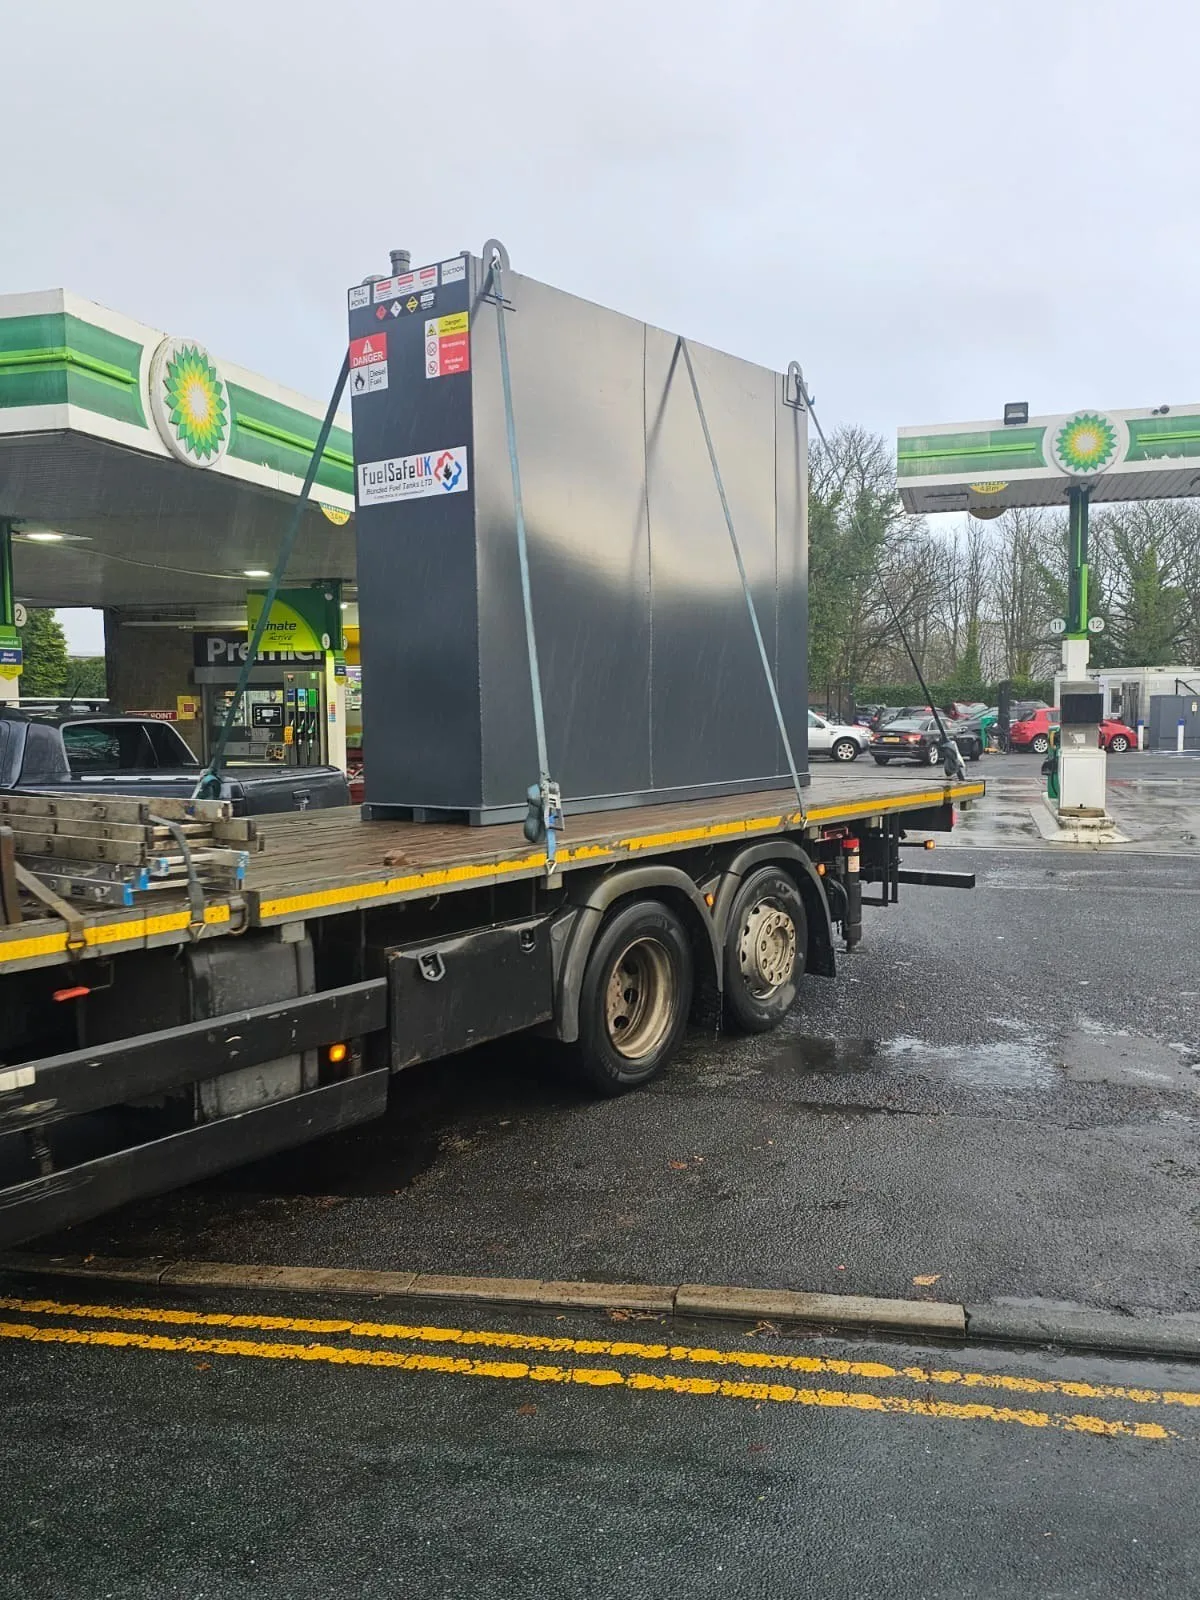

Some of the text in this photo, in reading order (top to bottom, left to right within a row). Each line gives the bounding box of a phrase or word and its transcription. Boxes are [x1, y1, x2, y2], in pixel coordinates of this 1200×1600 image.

[353, 288, 365, 297] FILL
[351, 297, 368, 306] POINT
[353, 351, 384, 367] DANGER
[370, 367, 386, 378] Diesel
[370, 376, 382, 386] Fuel
[363, 456, 433, 486] FuelSafeUK
[366, 486, 387, 495] Bunded
[389, 483, 401, 493] Fuel
[403, 481, 419, 490] Tanks
[421, 478, 433, 487] LTD
[16, 609, 22, 622] 2
[1052, 621, 1062, 630] 11
[1091, 620, 1103, 629] 12
